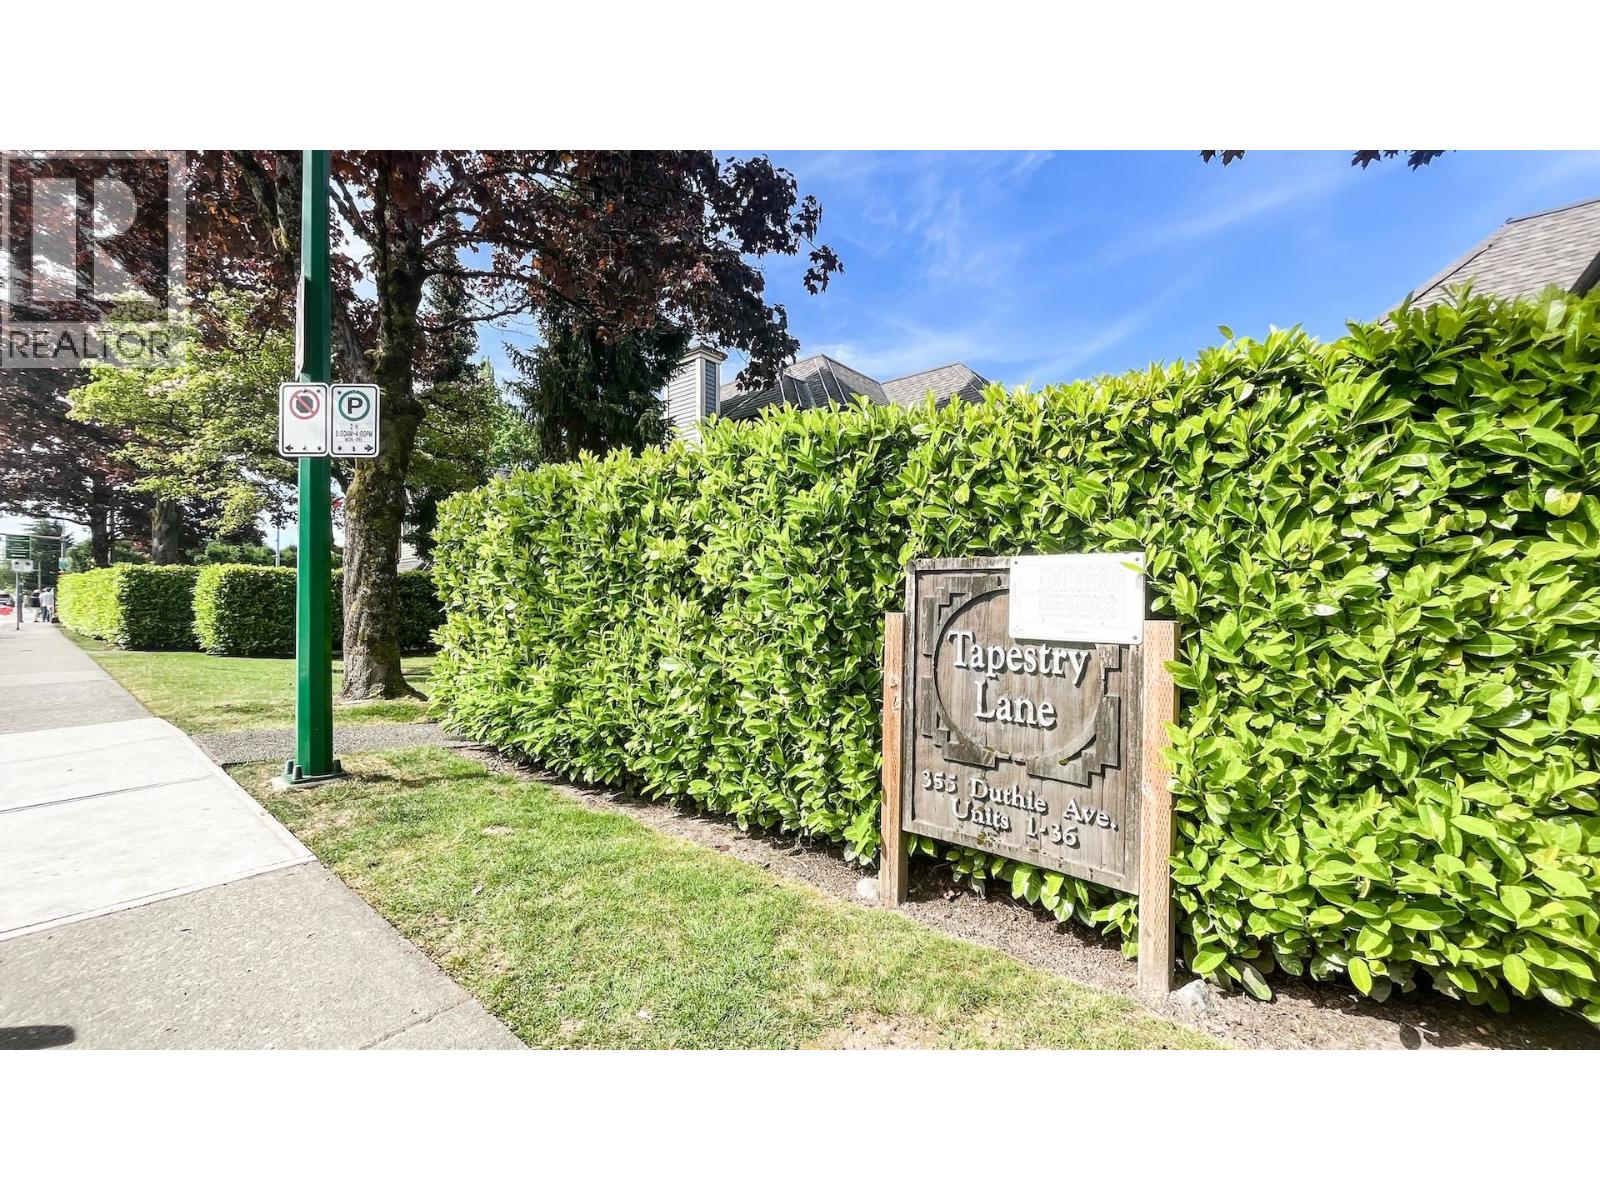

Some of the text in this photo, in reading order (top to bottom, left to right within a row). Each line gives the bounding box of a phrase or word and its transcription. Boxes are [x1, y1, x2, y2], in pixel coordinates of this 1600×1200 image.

[347, 397, 363, 414] P
[947, 630, 1090, 686] Tapestry
[974, 679, 1057, 728] Lane
[921, 770, 1119, 831] 355 Duthie Ave.
[951, 796, 1079, 847] Units 1-36
